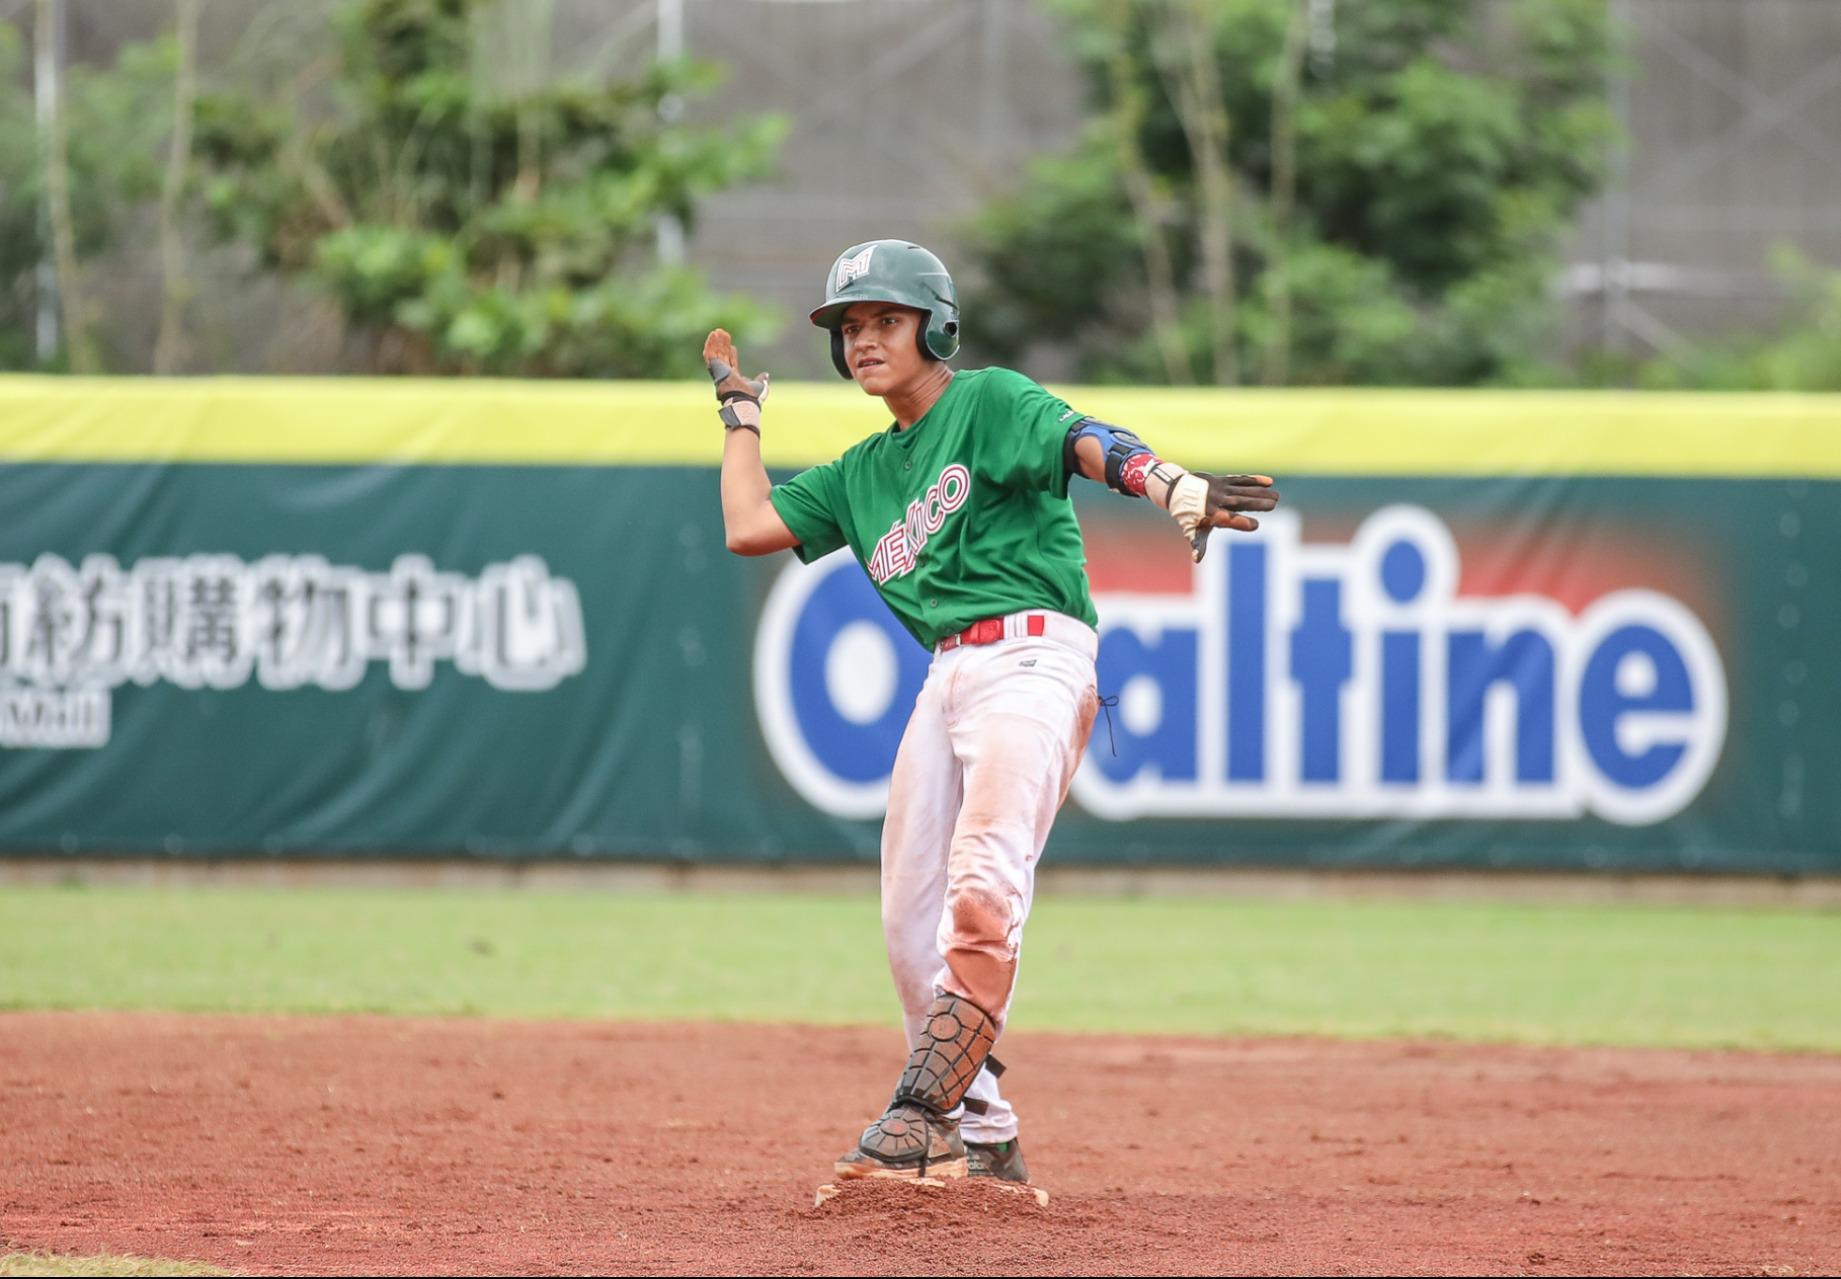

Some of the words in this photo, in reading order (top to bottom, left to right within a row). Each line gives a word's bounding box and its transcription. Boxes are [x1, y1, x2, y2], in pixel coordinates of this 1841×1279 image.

[835, 244, 878, 292] M
[865, 463, 970, 586] MÉXICO
[756, 508, 1724, 824] Oaltine
